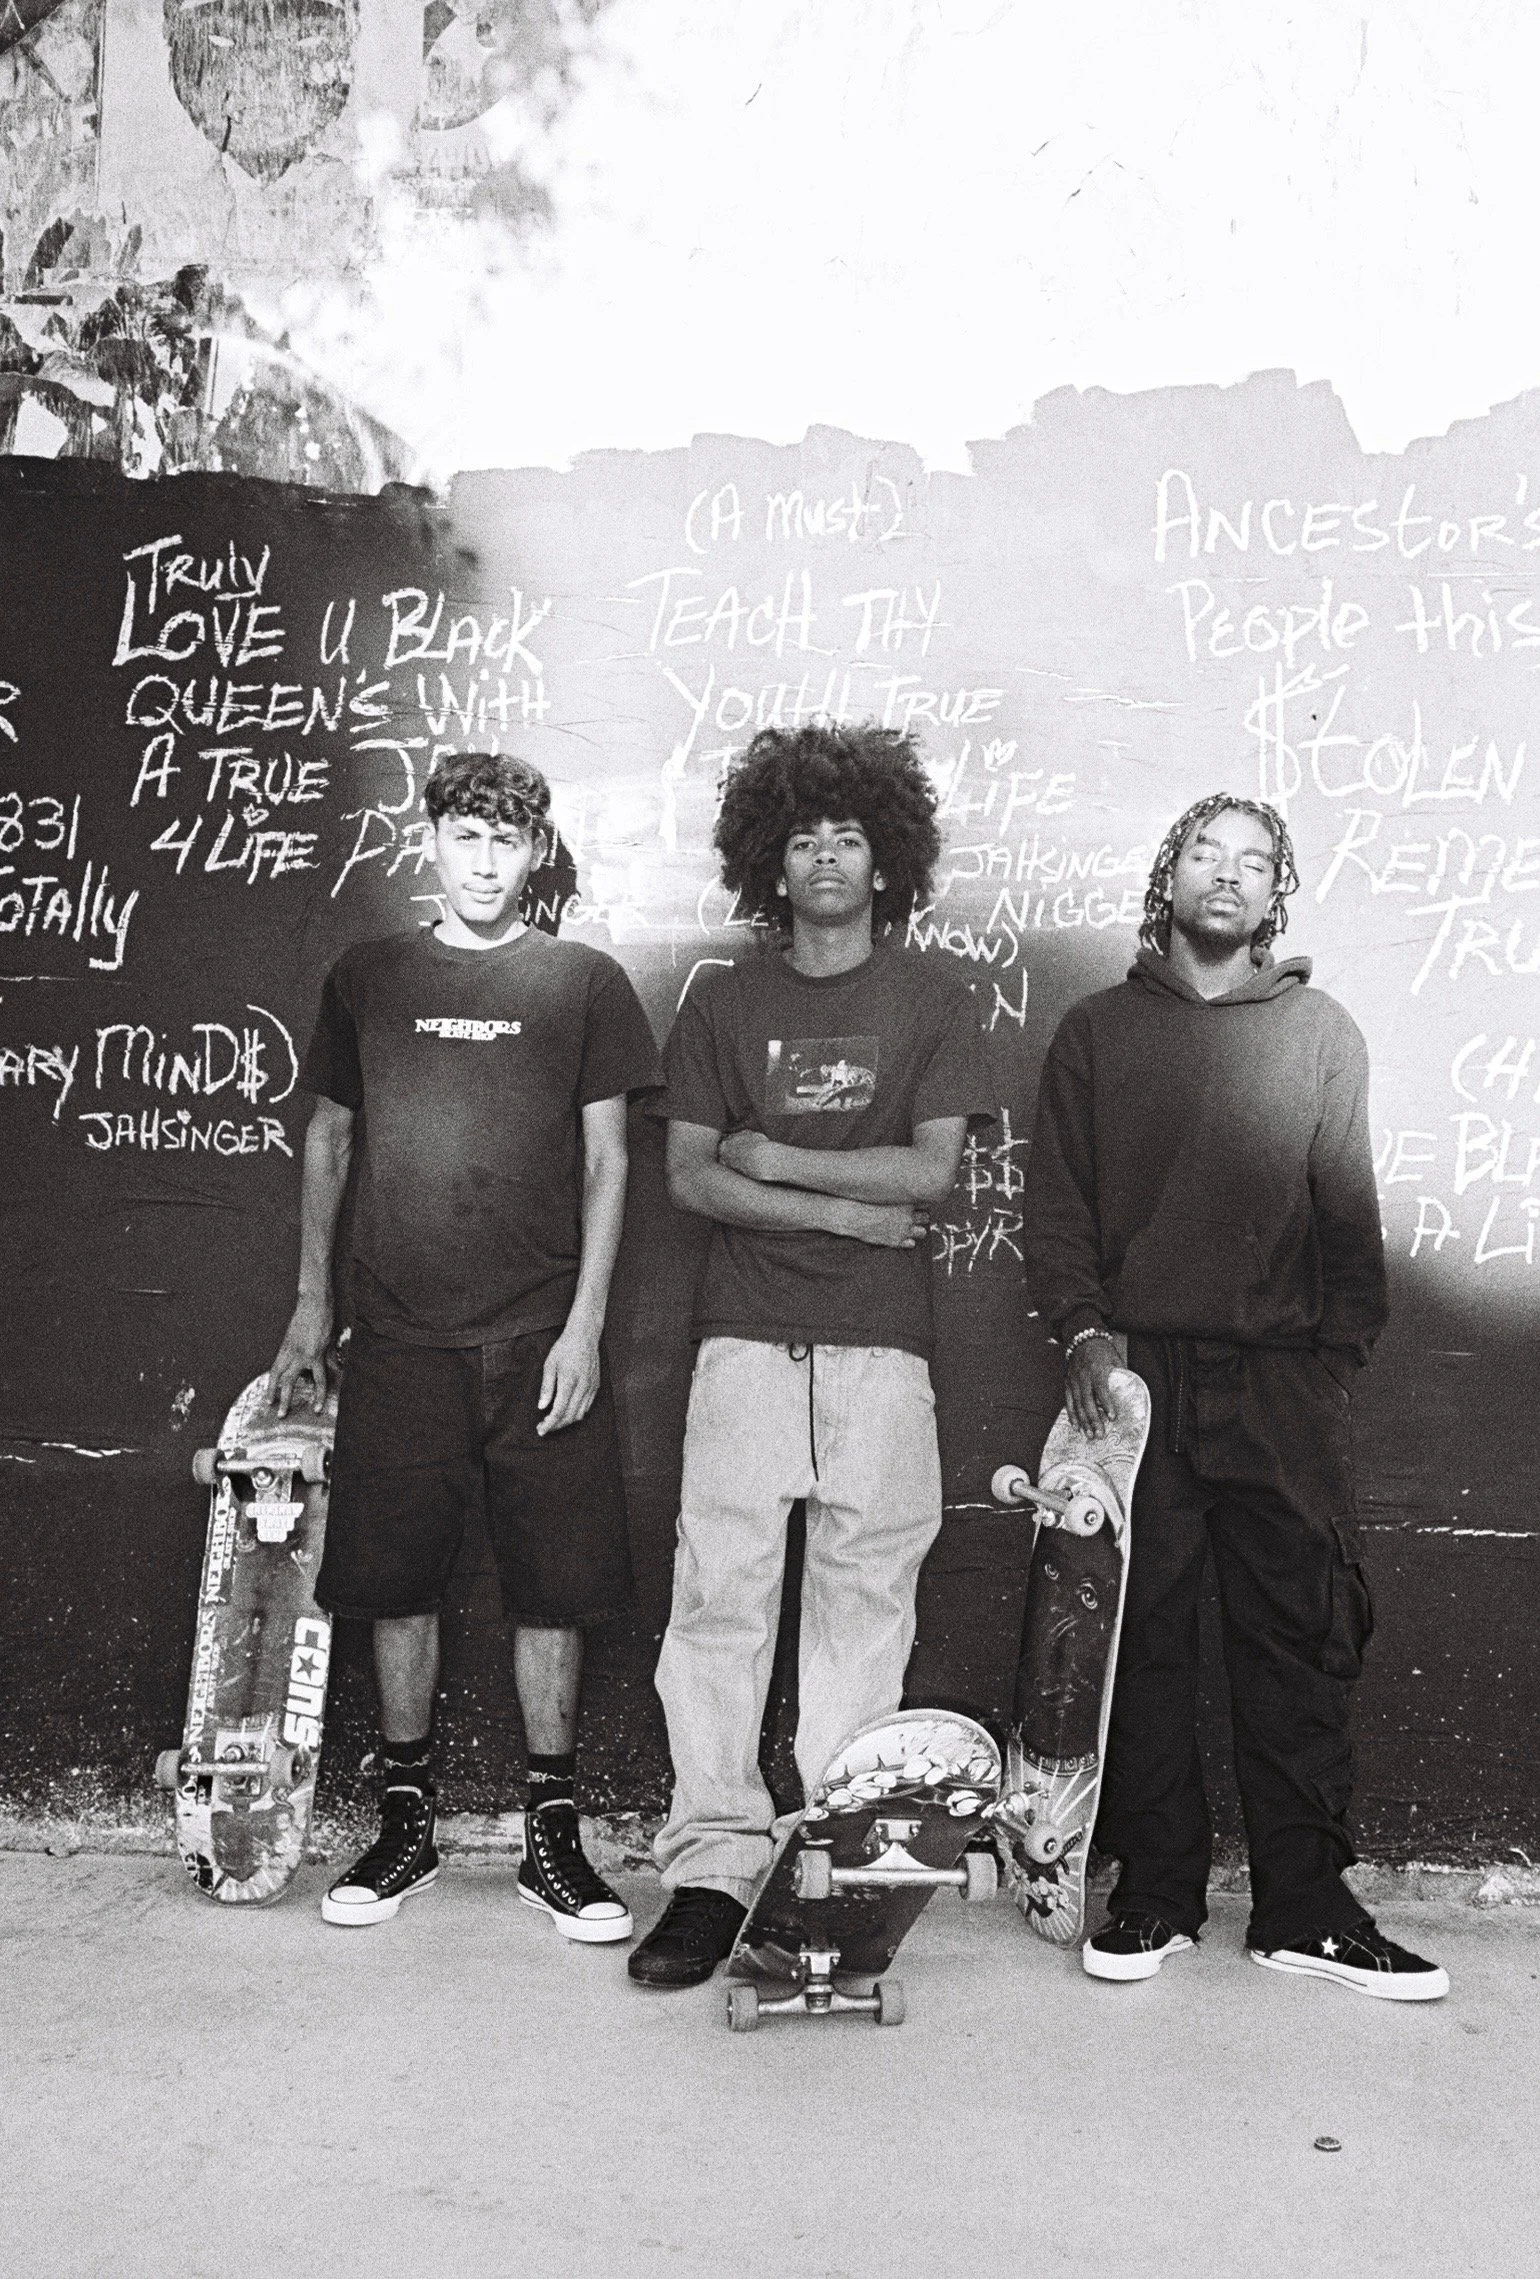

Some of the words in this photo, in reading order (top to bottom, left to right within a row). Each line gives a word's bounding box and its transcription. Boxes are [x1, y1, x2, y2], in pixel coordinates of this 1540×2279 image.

[112, 571, 286, 666] LOVE
[130, 732, 181, 807] A
[199, 746, 331, 804] TRUE
[150, 814, 202, 875] 4
[415, 1018, 522, 1035] NEIGHBORS
